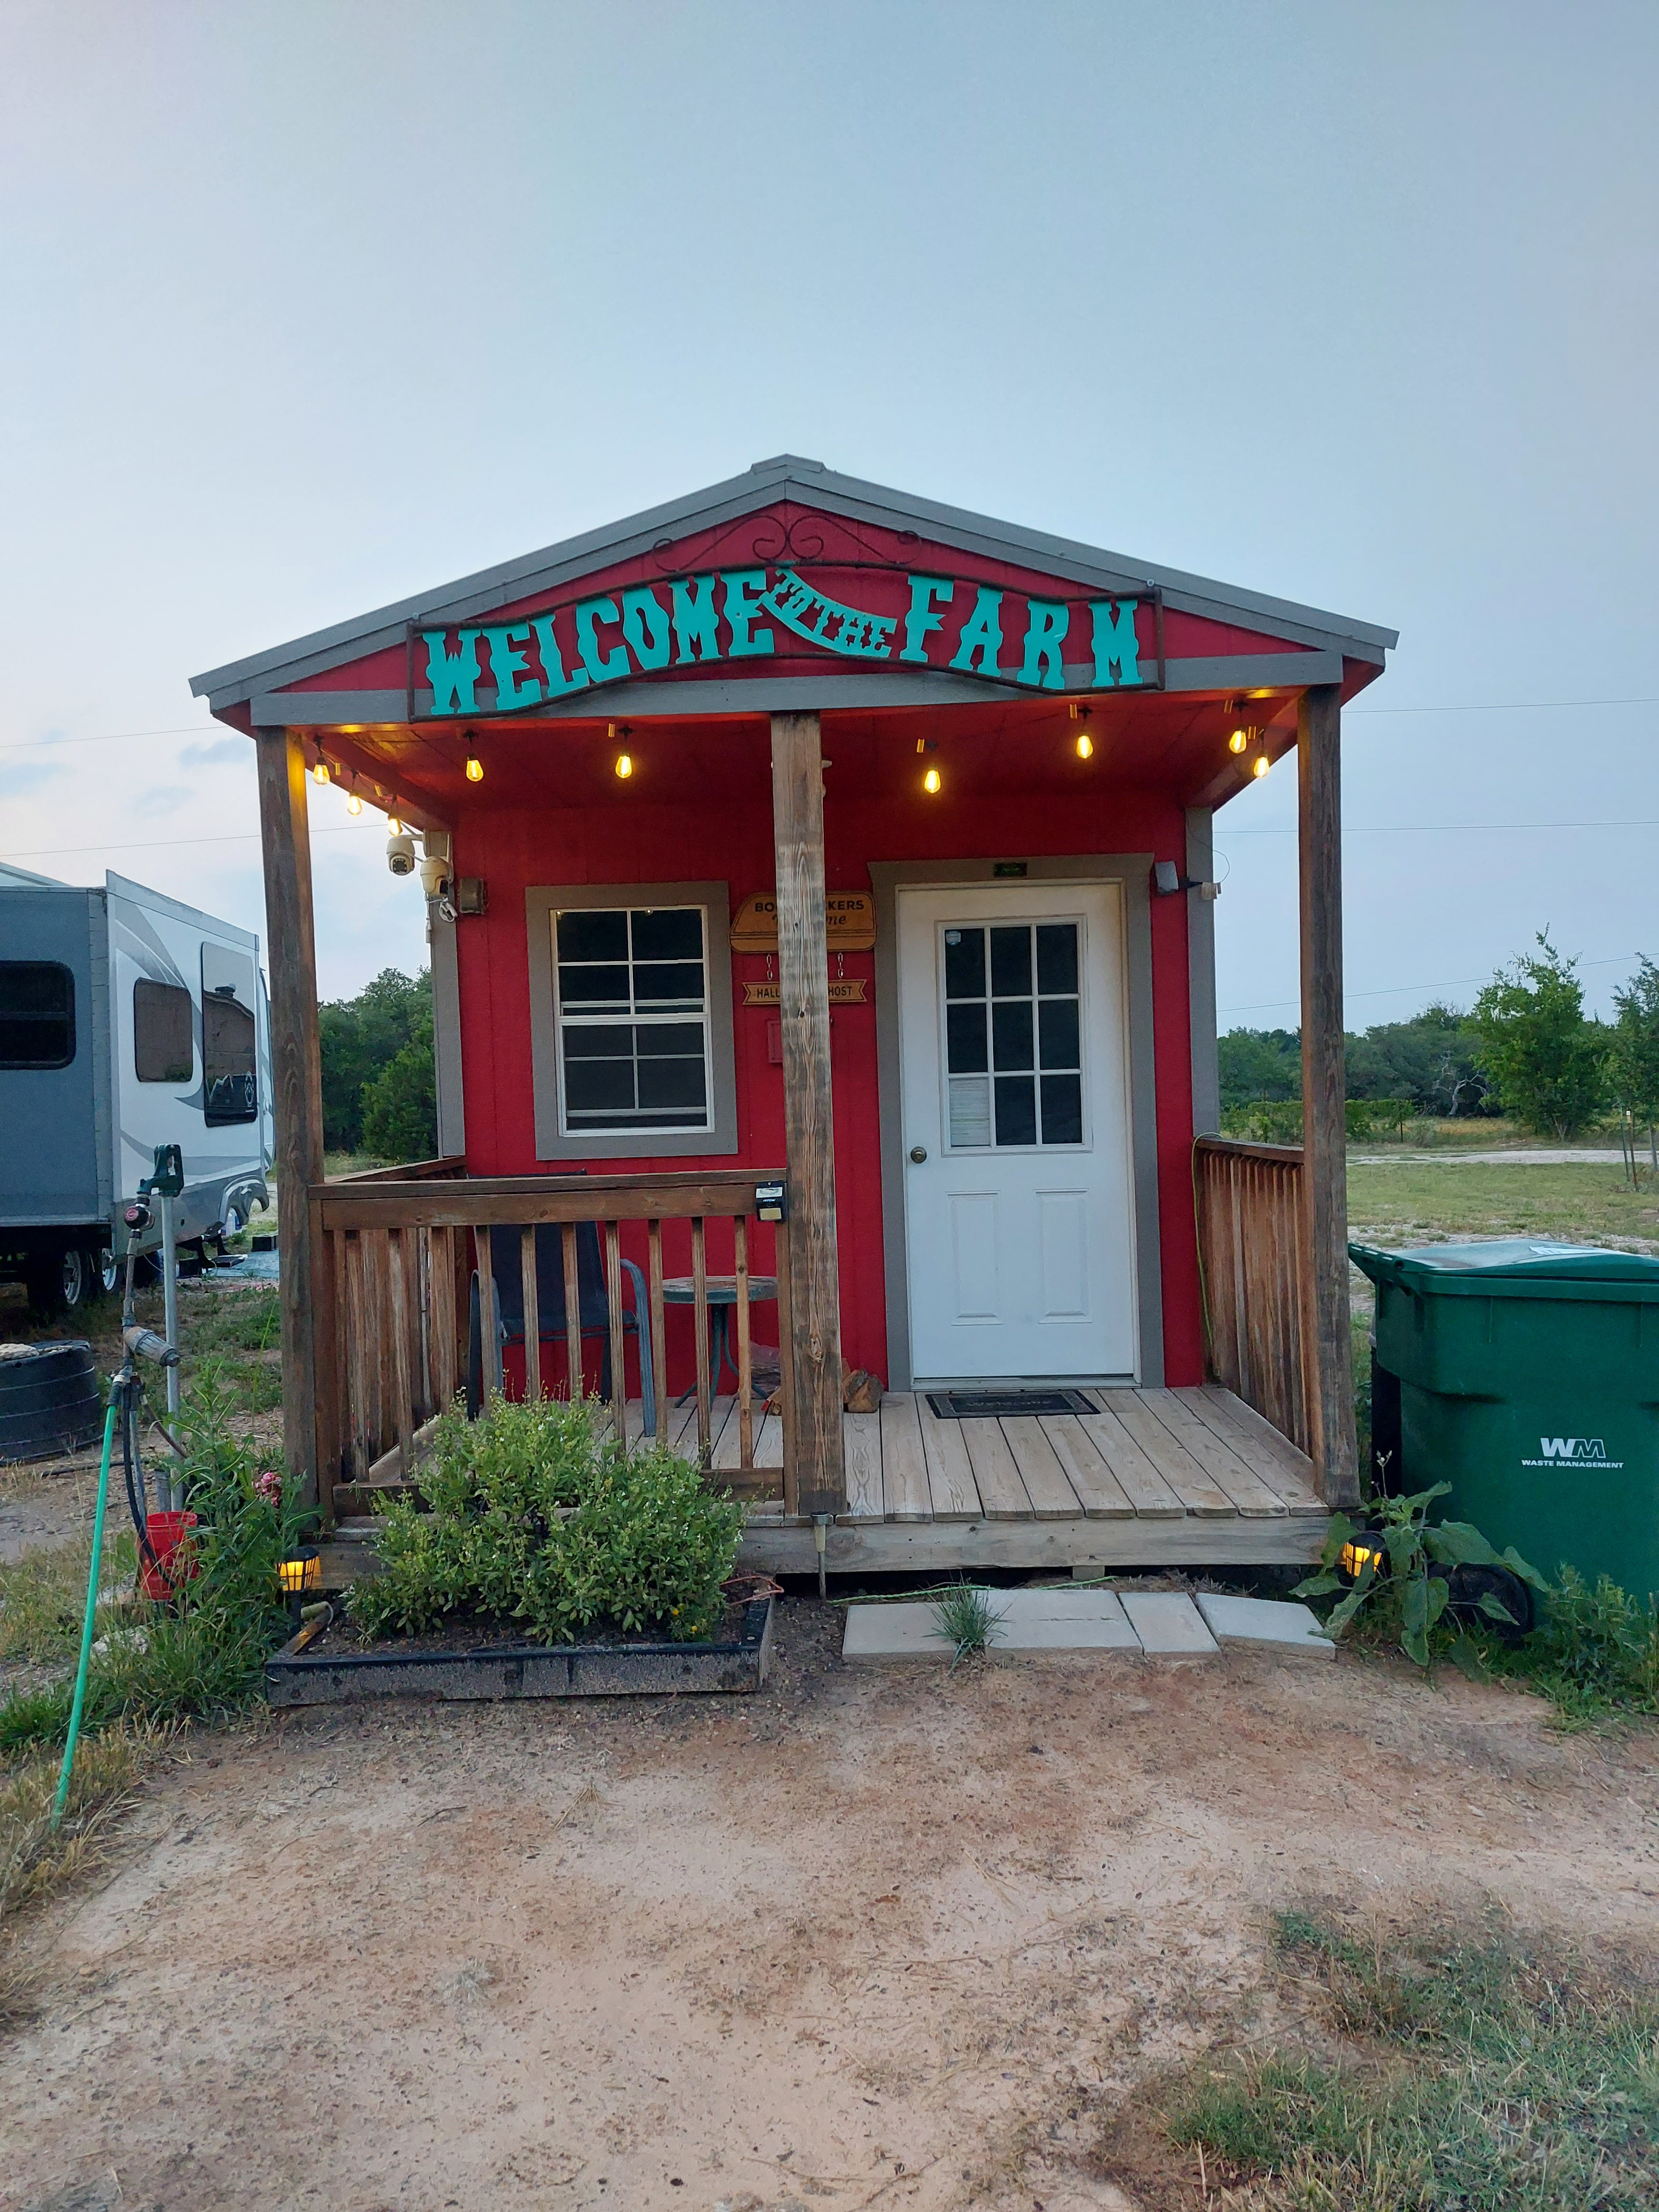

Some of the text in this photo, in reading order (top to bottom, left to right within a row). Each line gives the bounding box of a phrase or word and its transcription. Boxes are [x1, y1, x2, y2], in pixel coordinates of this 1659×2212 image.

[422, 569, 775, 715] WELCOME
[810, 596, 898, 658] THE
[899, 574, 1144, 690] FARM
[757, 986, 852, 998] HALL HOST
[1540, 1438, 1606, 1459] WM
[1556, 1460, 1625, 1469] MANAGEMENT
